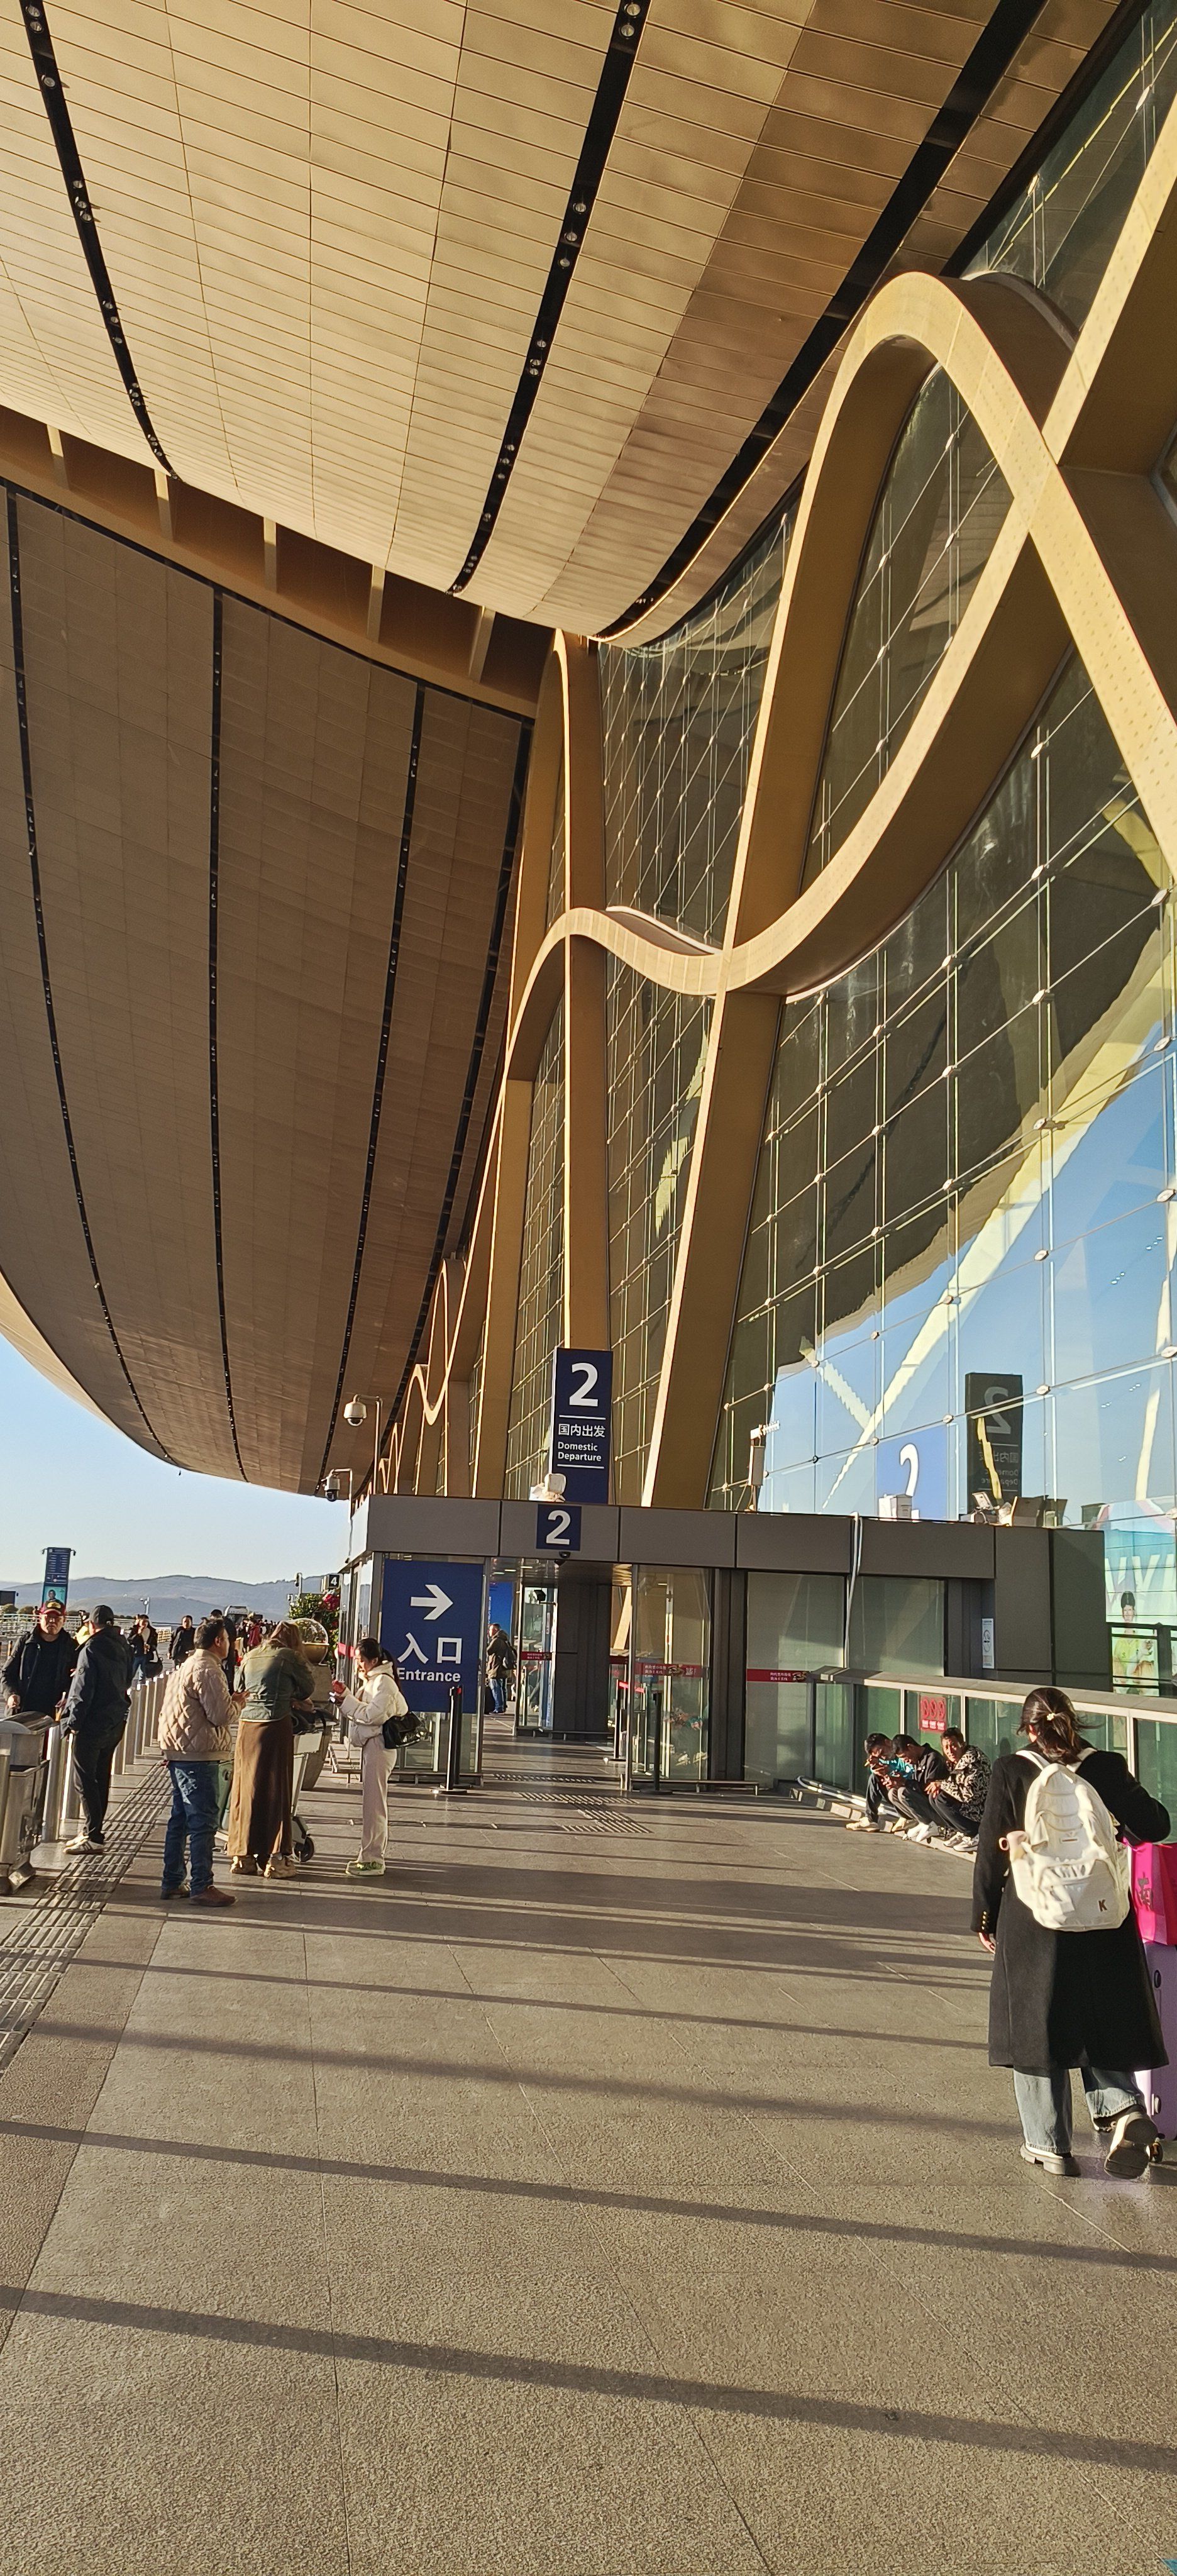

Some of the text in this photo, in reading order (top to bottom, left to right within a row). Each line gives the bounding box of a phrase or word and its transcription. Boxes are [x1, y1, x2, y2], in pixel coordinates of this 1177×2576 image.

[569, 1362, 599, 1407] 2
[558, 1423, 605, 1438] 国内出发
[558, 1441, 598, 1451] Domestic
[558, 1452, 602, 1462] Departure
[546, 1510, 571, 1545] 2
[330, 1577, 338, 1585] 4
[397, 1632, 462, 1664] 入口
[397, 1667, 461, 1682] Entrance
[1098, 1899, 1108, 1912] K
